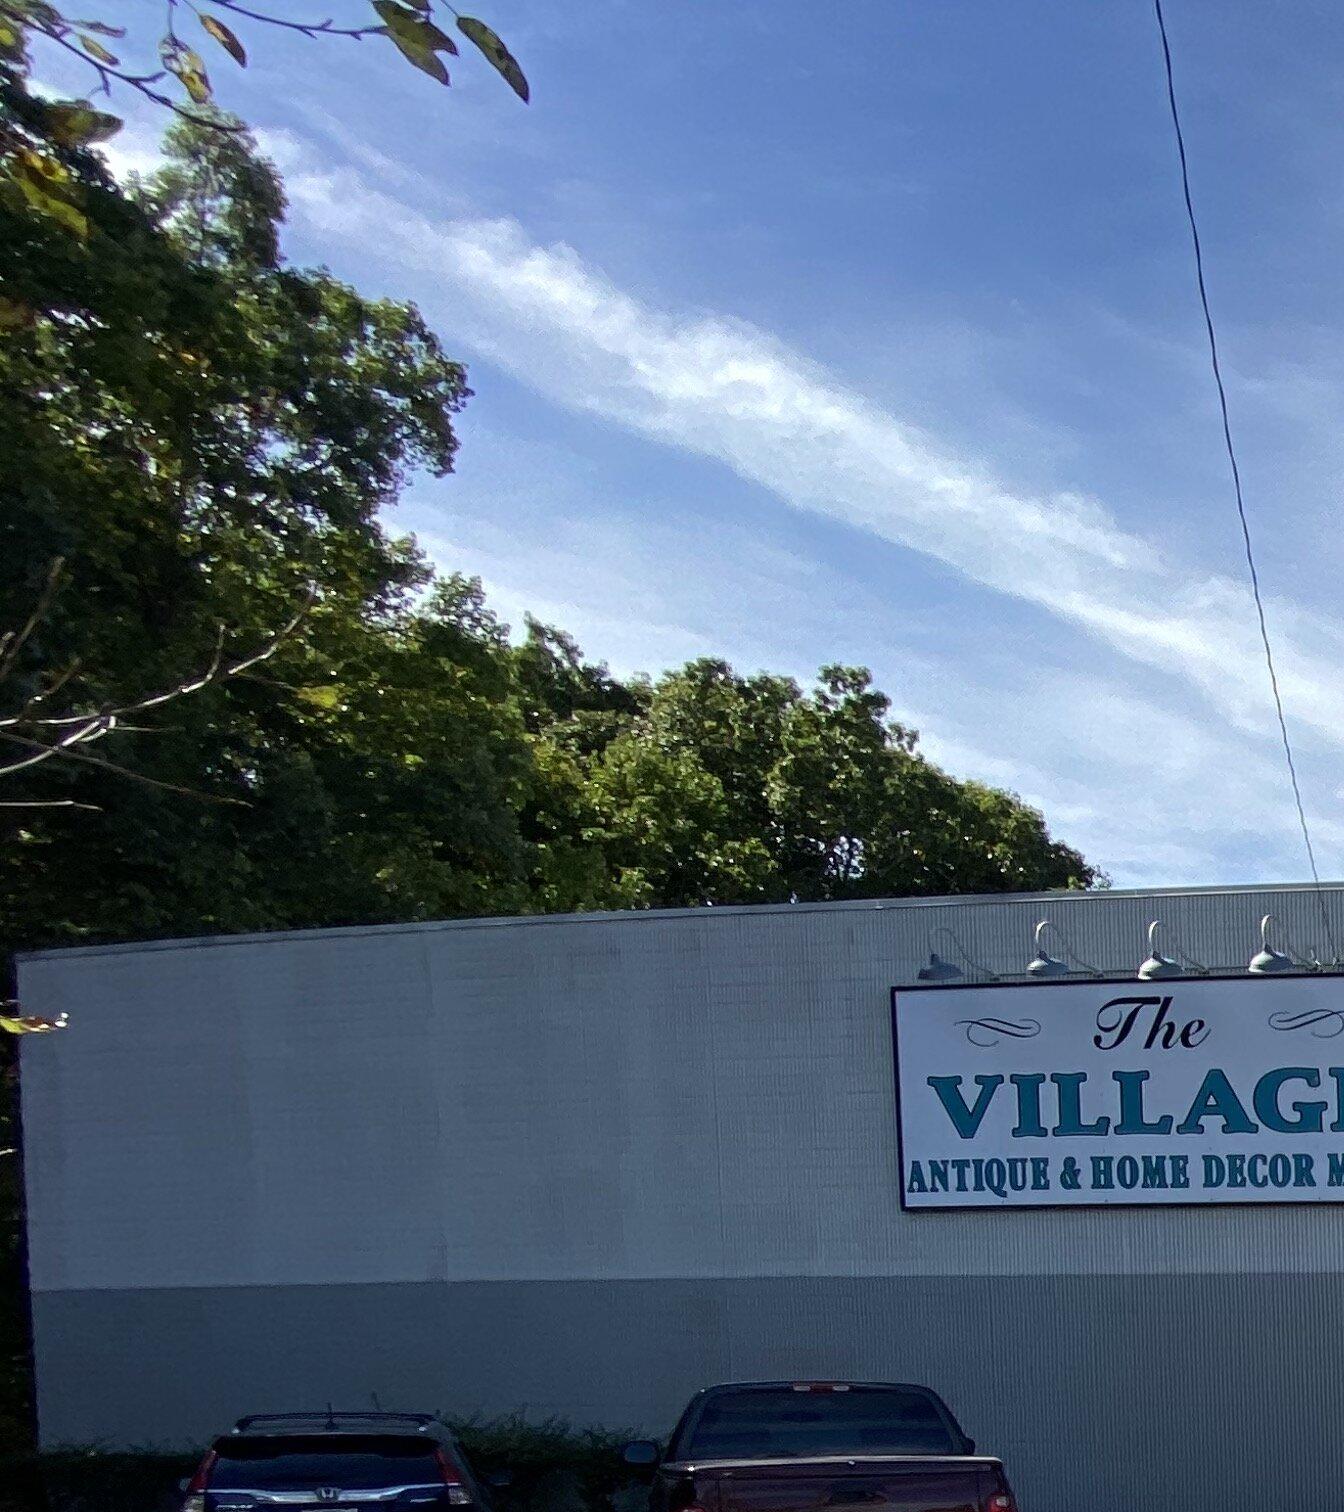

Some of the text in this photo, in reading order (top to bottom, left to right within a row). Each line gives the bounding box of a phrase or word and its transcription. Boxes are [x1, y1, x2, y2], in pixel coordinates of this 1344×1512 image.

[1094, 996, 1211, 1050] The
[907, 1156, 1049, 1198] ANTIQUE
[1060, 1156, 1081, 1191] &
[1090, 1155, 1189, 1189] HOME
[1203, 1153, 1316, 1188] DECOR
